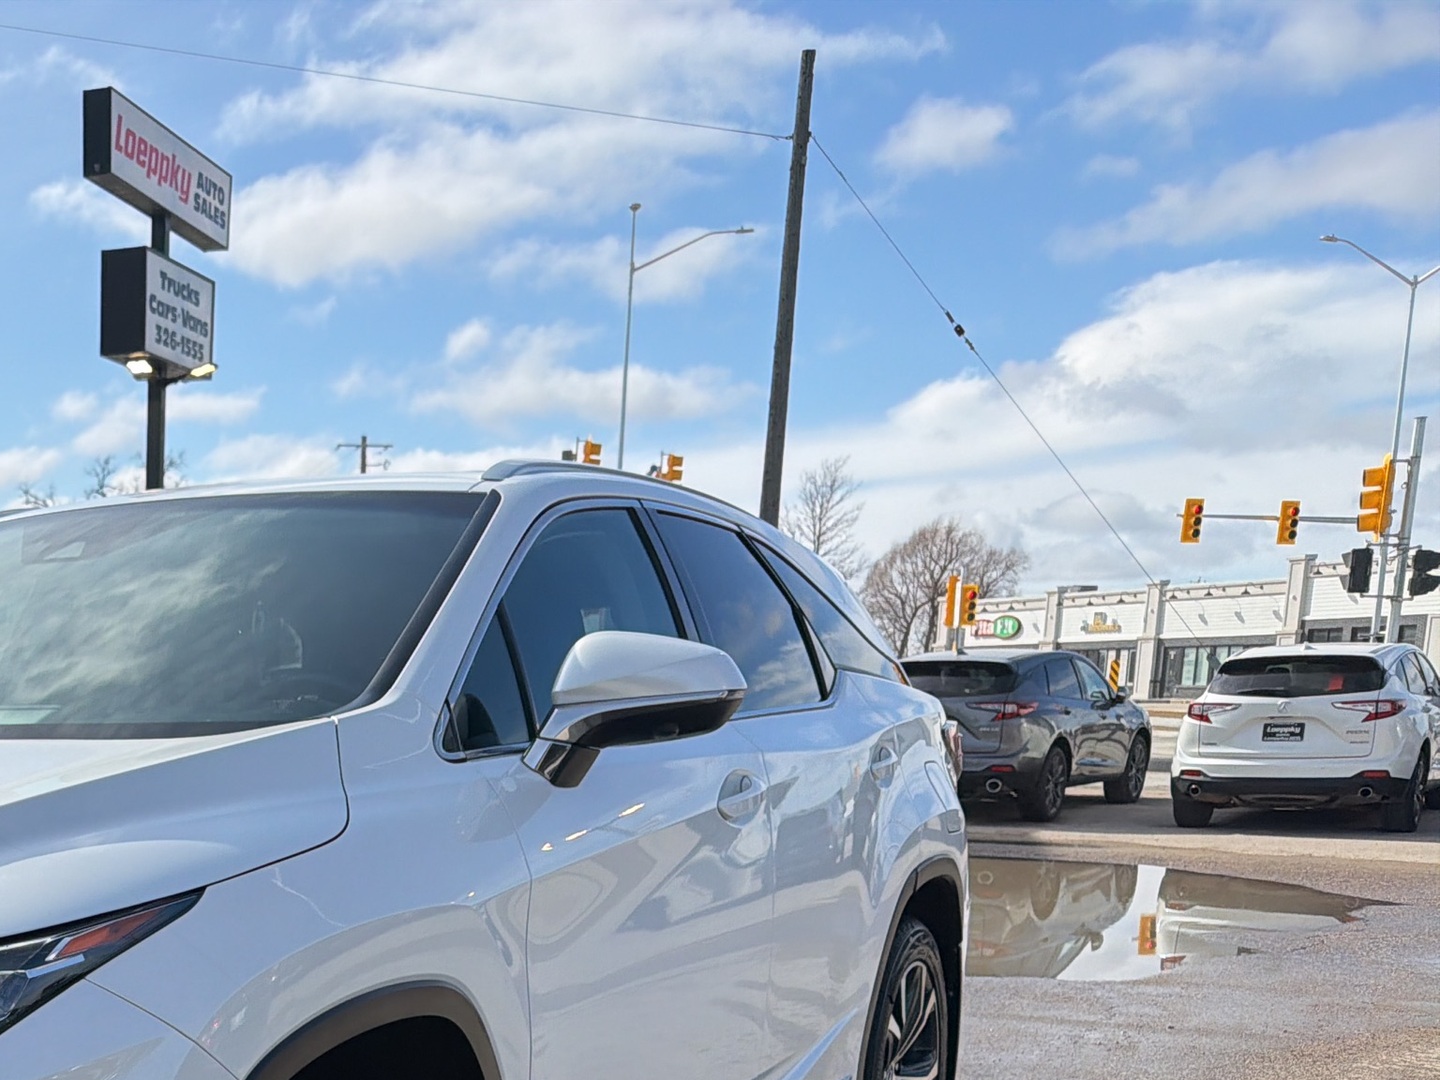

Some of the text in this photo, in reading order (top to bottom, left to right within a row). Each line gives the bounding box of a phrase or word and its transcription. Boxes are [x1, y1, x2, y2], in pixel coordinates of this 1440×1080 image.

[114, 113, 192, 206] Loeppky
[196, 171, 225, 206] AUTO
[193, 192, 226, 230] SALES
[159, 269, 200, 308] Trucks
[154, 323, 204, 363] 326-1555
